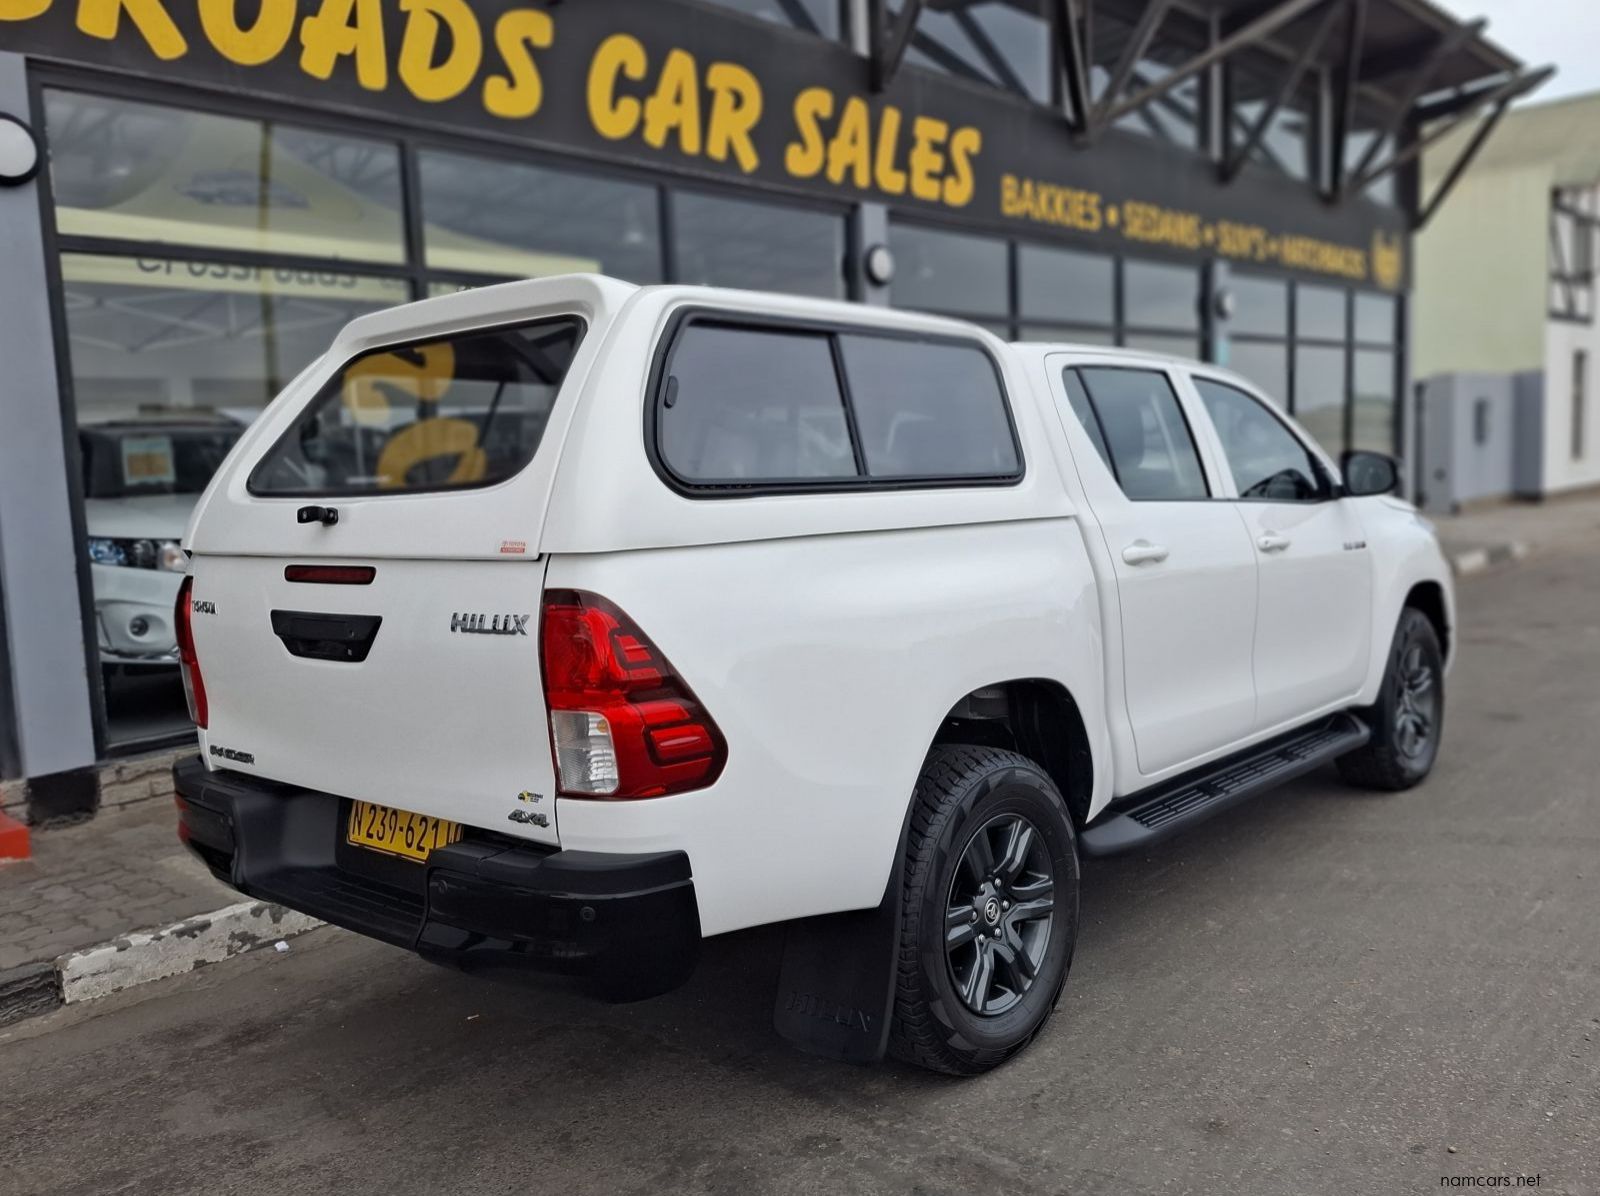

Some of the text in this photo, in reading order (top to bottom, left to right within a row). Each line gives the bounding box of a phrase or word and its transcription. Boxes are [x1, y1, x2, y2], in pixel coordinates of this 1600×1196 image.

[587, 34, 763, 173] CAR
[785, 88, 982, 206] SALES
[1001, 174, 1102, 232] BAKKIES
[450, 612, 530, 636] HILUX
